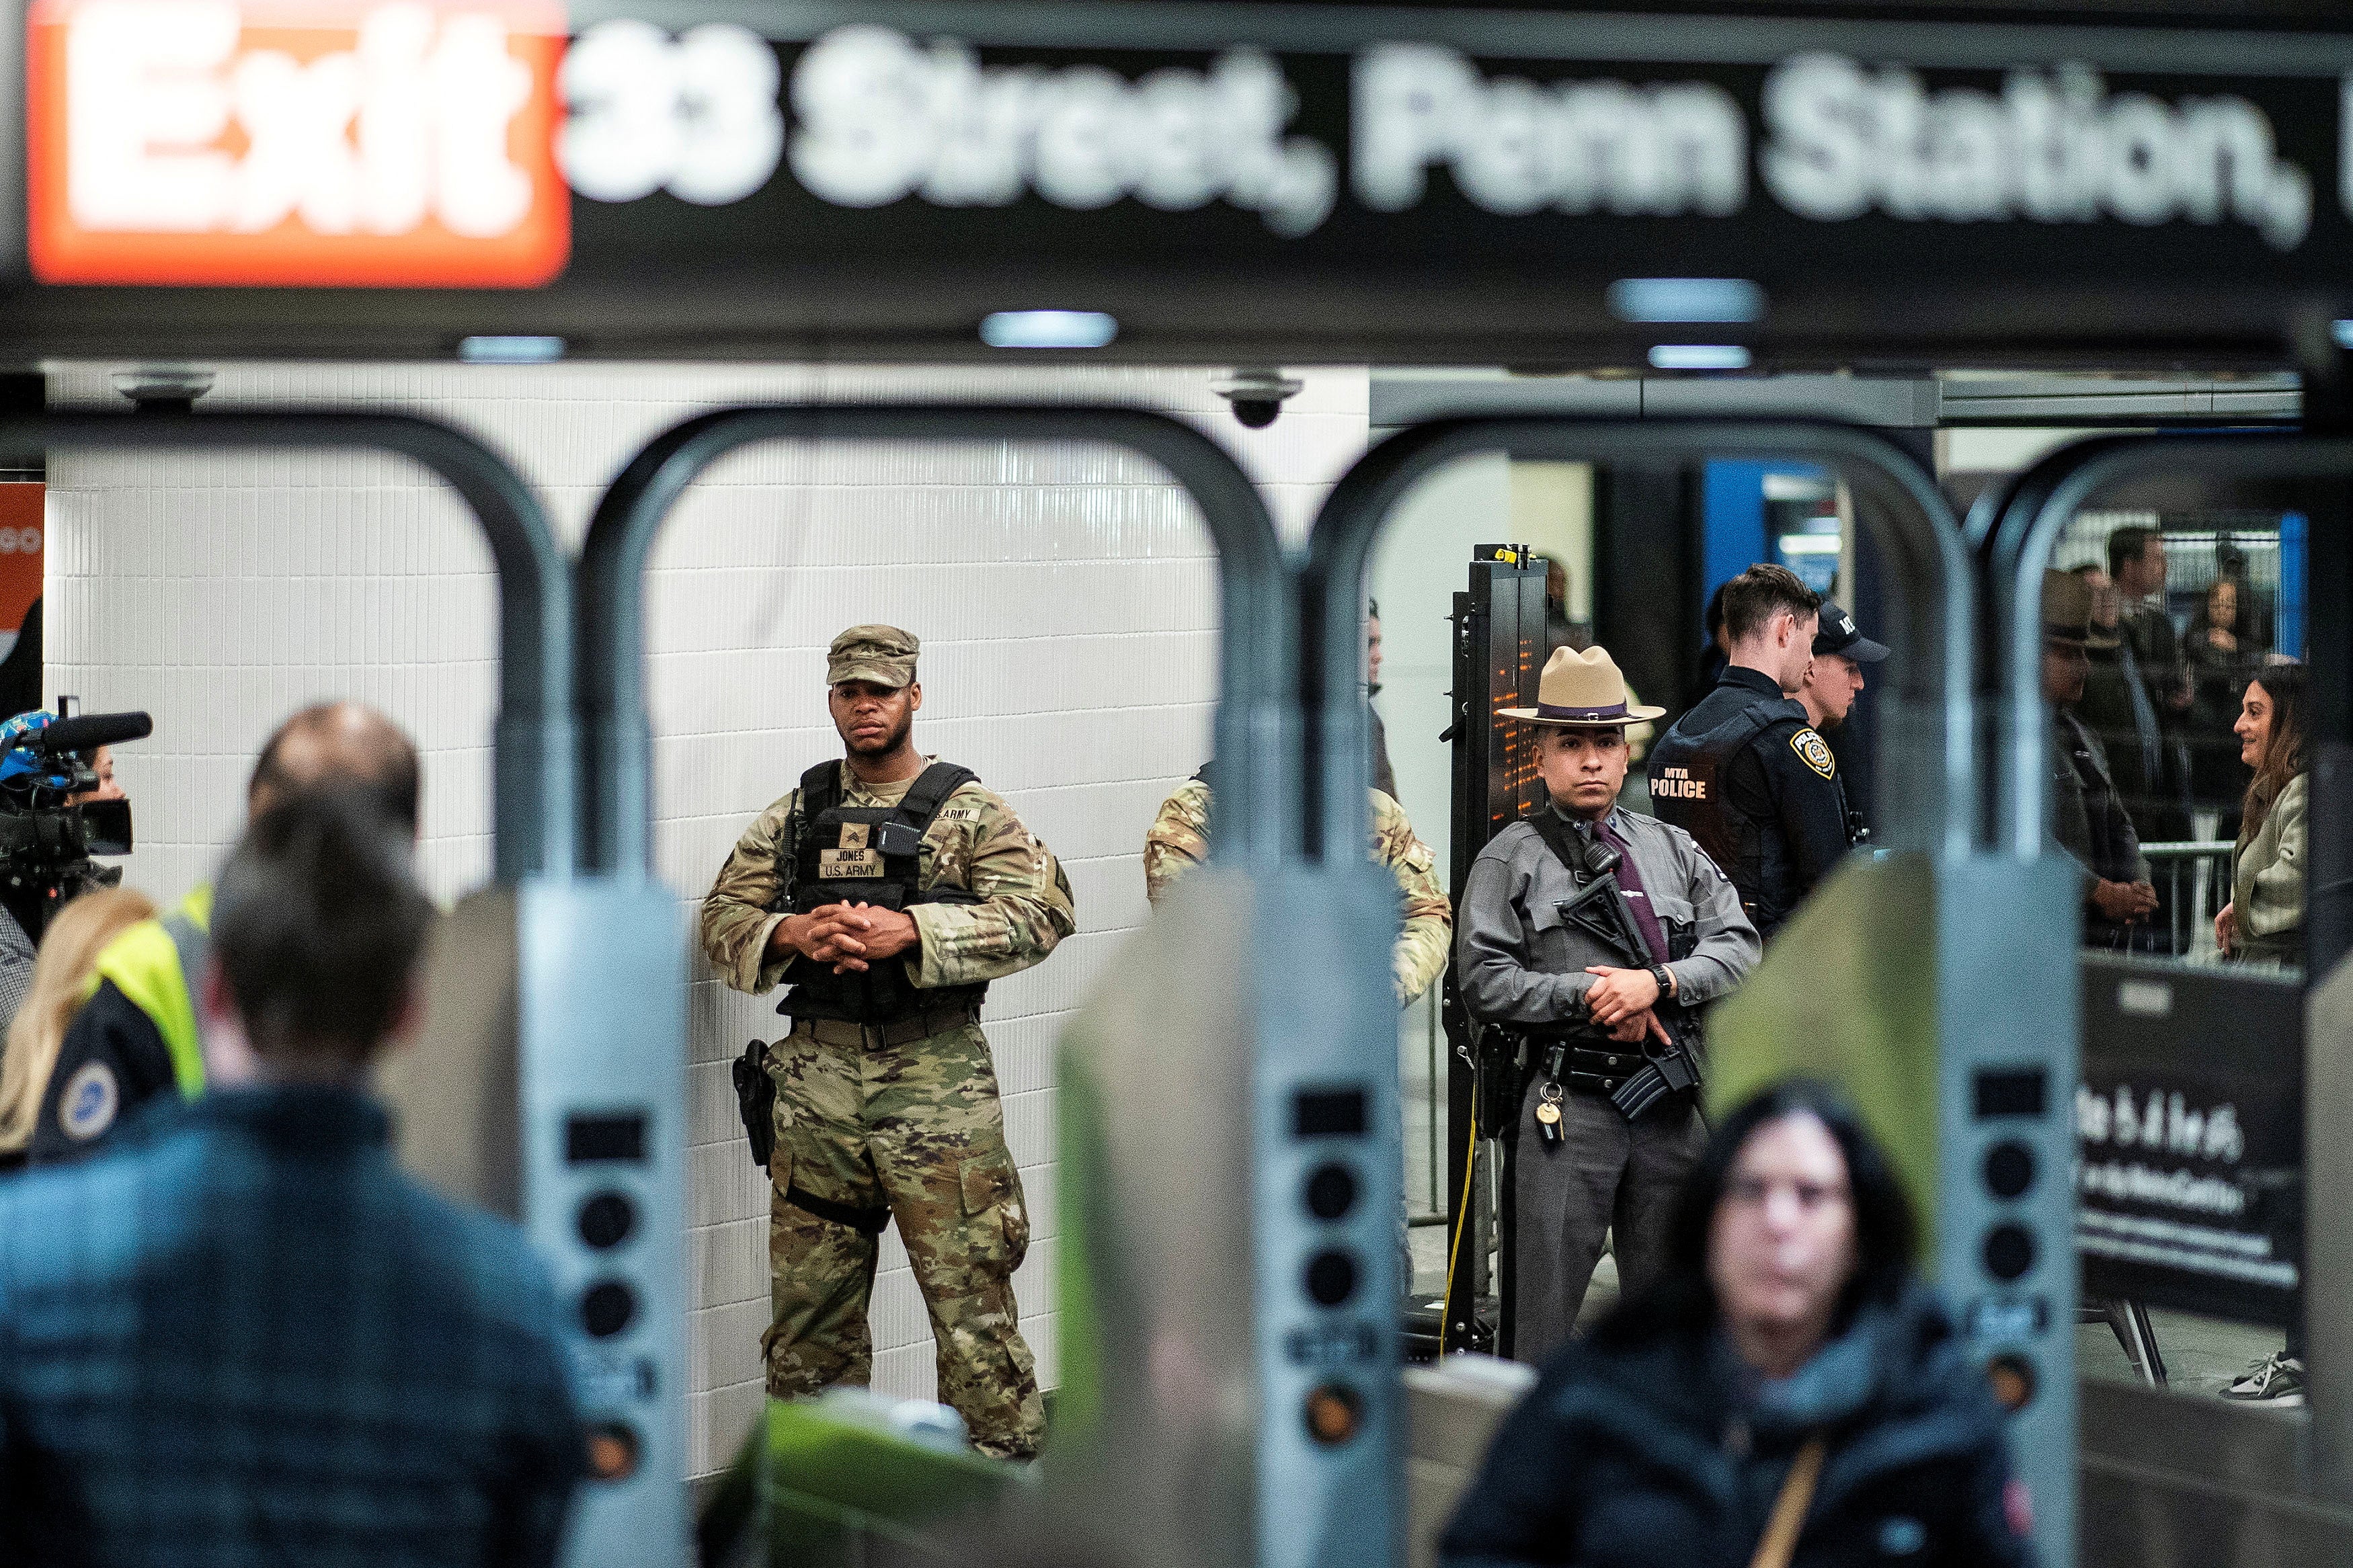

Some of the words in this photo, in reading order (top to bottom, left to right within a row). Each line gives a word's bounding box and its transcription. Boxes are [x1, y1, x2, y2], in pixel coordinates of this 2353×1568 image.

[66, 0, 532, 237] Exit
[554, 19, 784, 206] 33
[788, 23, 1338, 239] Street,
[1349, 40, 1751, 218] Penn
[1761, 51, 2313, 250] Station,
[1665, 768, 1688, 779] MTA
[1651, 778, 1706, 798] POLICE
[943, 809, 971, 819] ARMY
[836, 850, 865, 862] JONES
[826, 865, 842, 876] U.S.
[846, 864, 876, 876] ARMY
